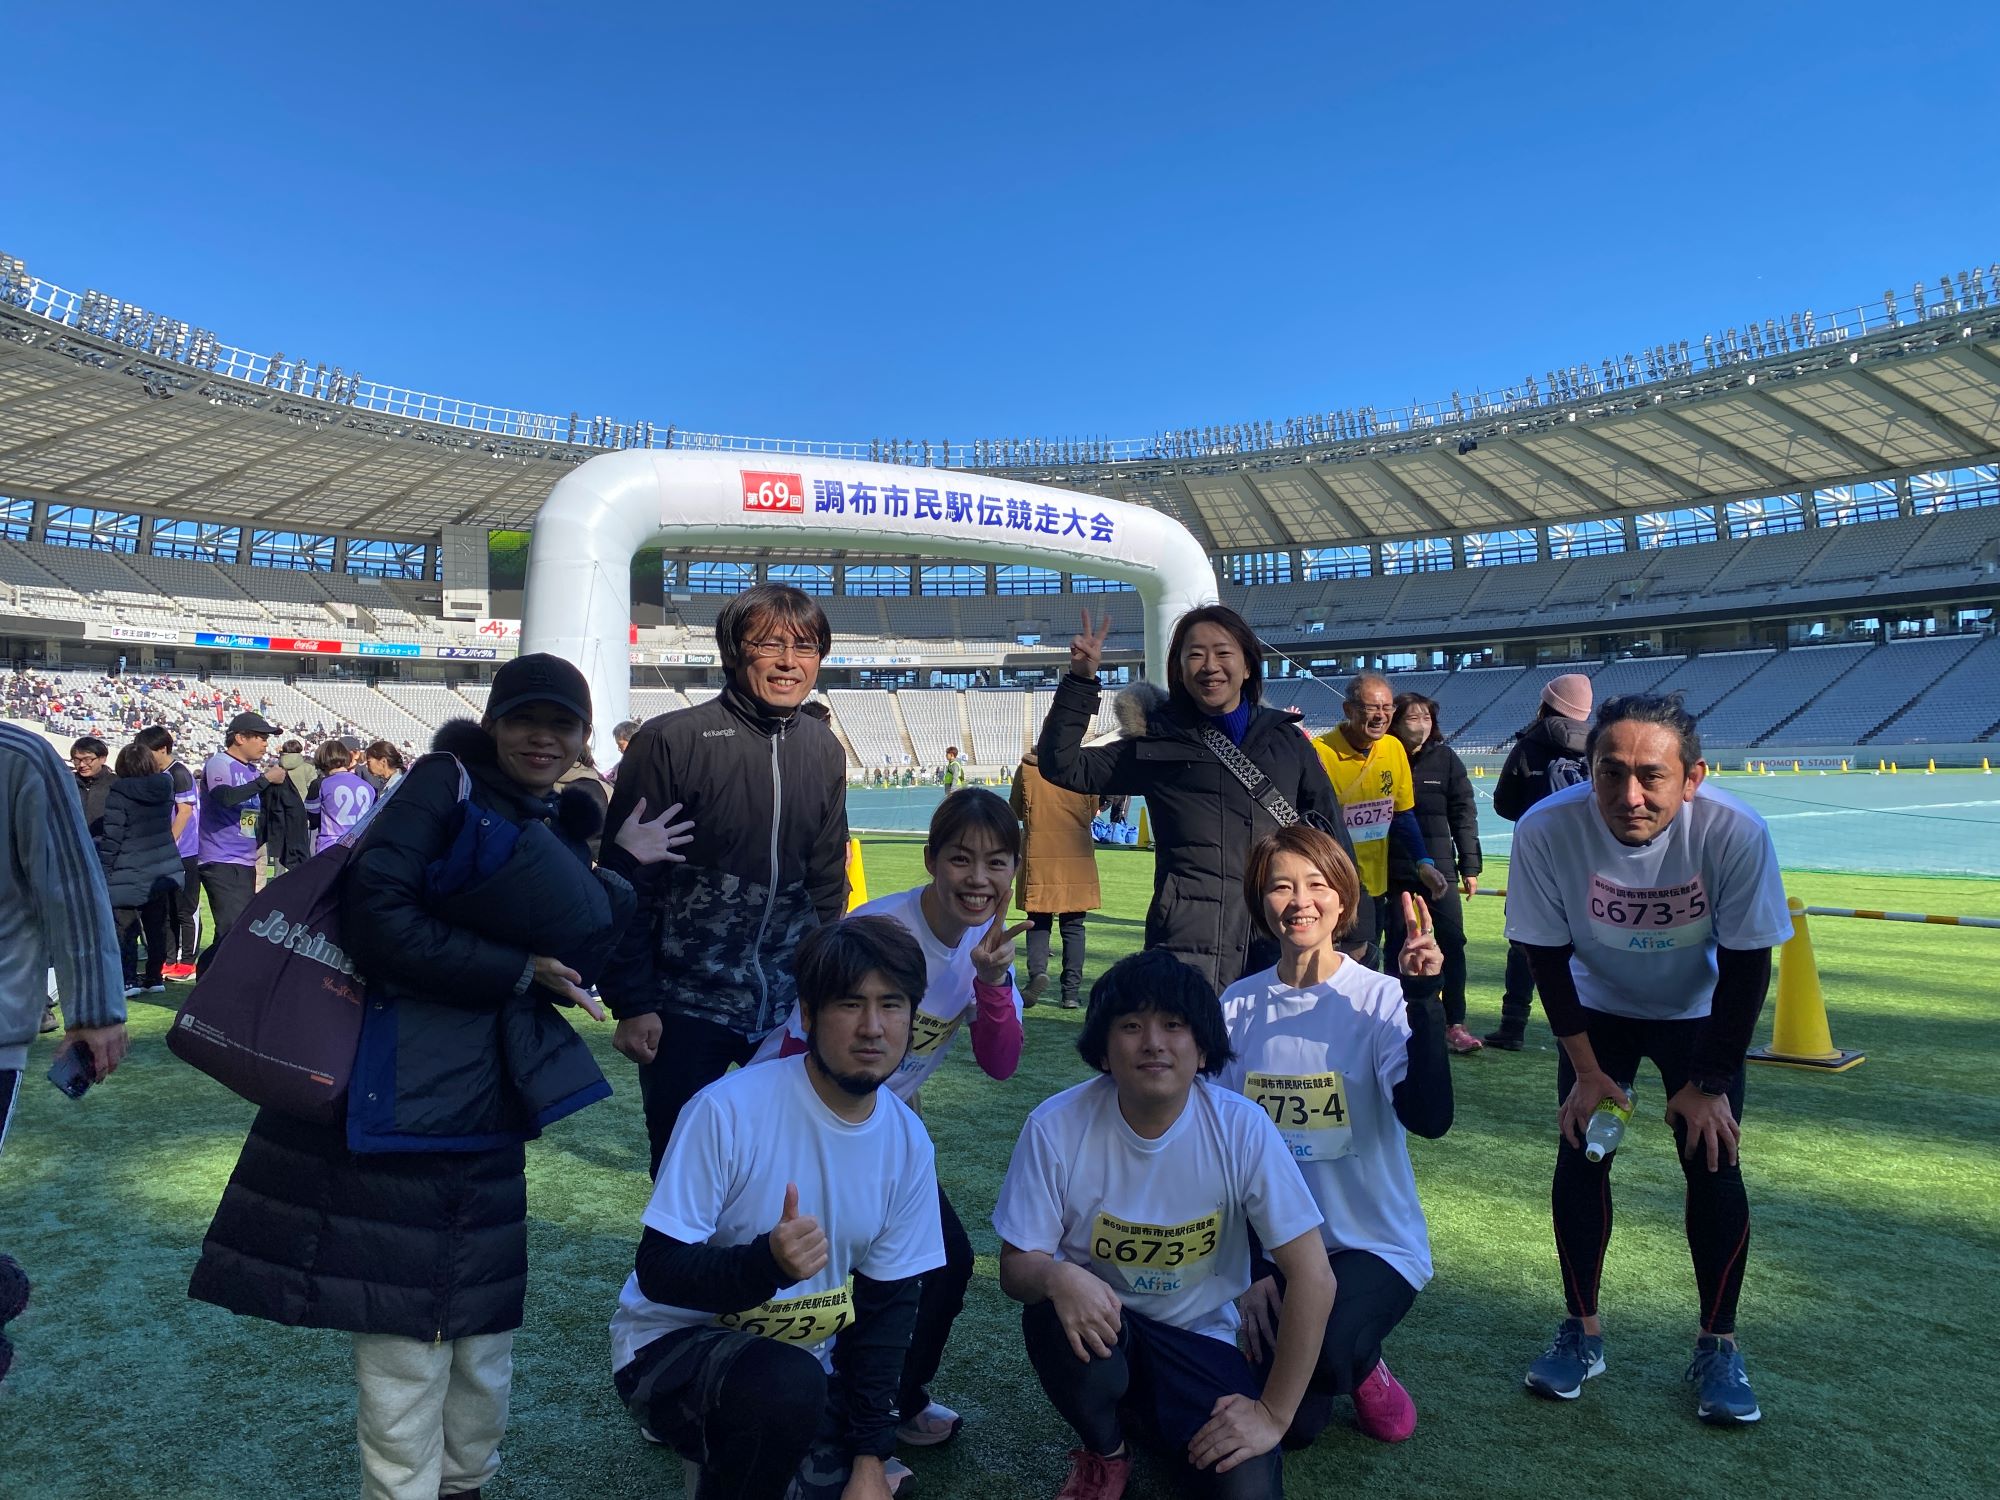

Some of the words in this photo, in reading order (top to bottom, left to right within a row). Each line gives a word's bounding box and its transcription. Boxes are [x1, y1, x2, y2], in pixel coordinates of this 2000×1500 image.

[746, 481, 801, 508] 第69回
[813, 479, 1115, 543] 調布市民駅伝競走大会
[687, 655, 713, 664] Blendy
[1591, 892, 1706, 925] C673-5
[1095, 1230, 1216, 1266] C673-3
[1133, 1275, 1181, 1292] Aflac
